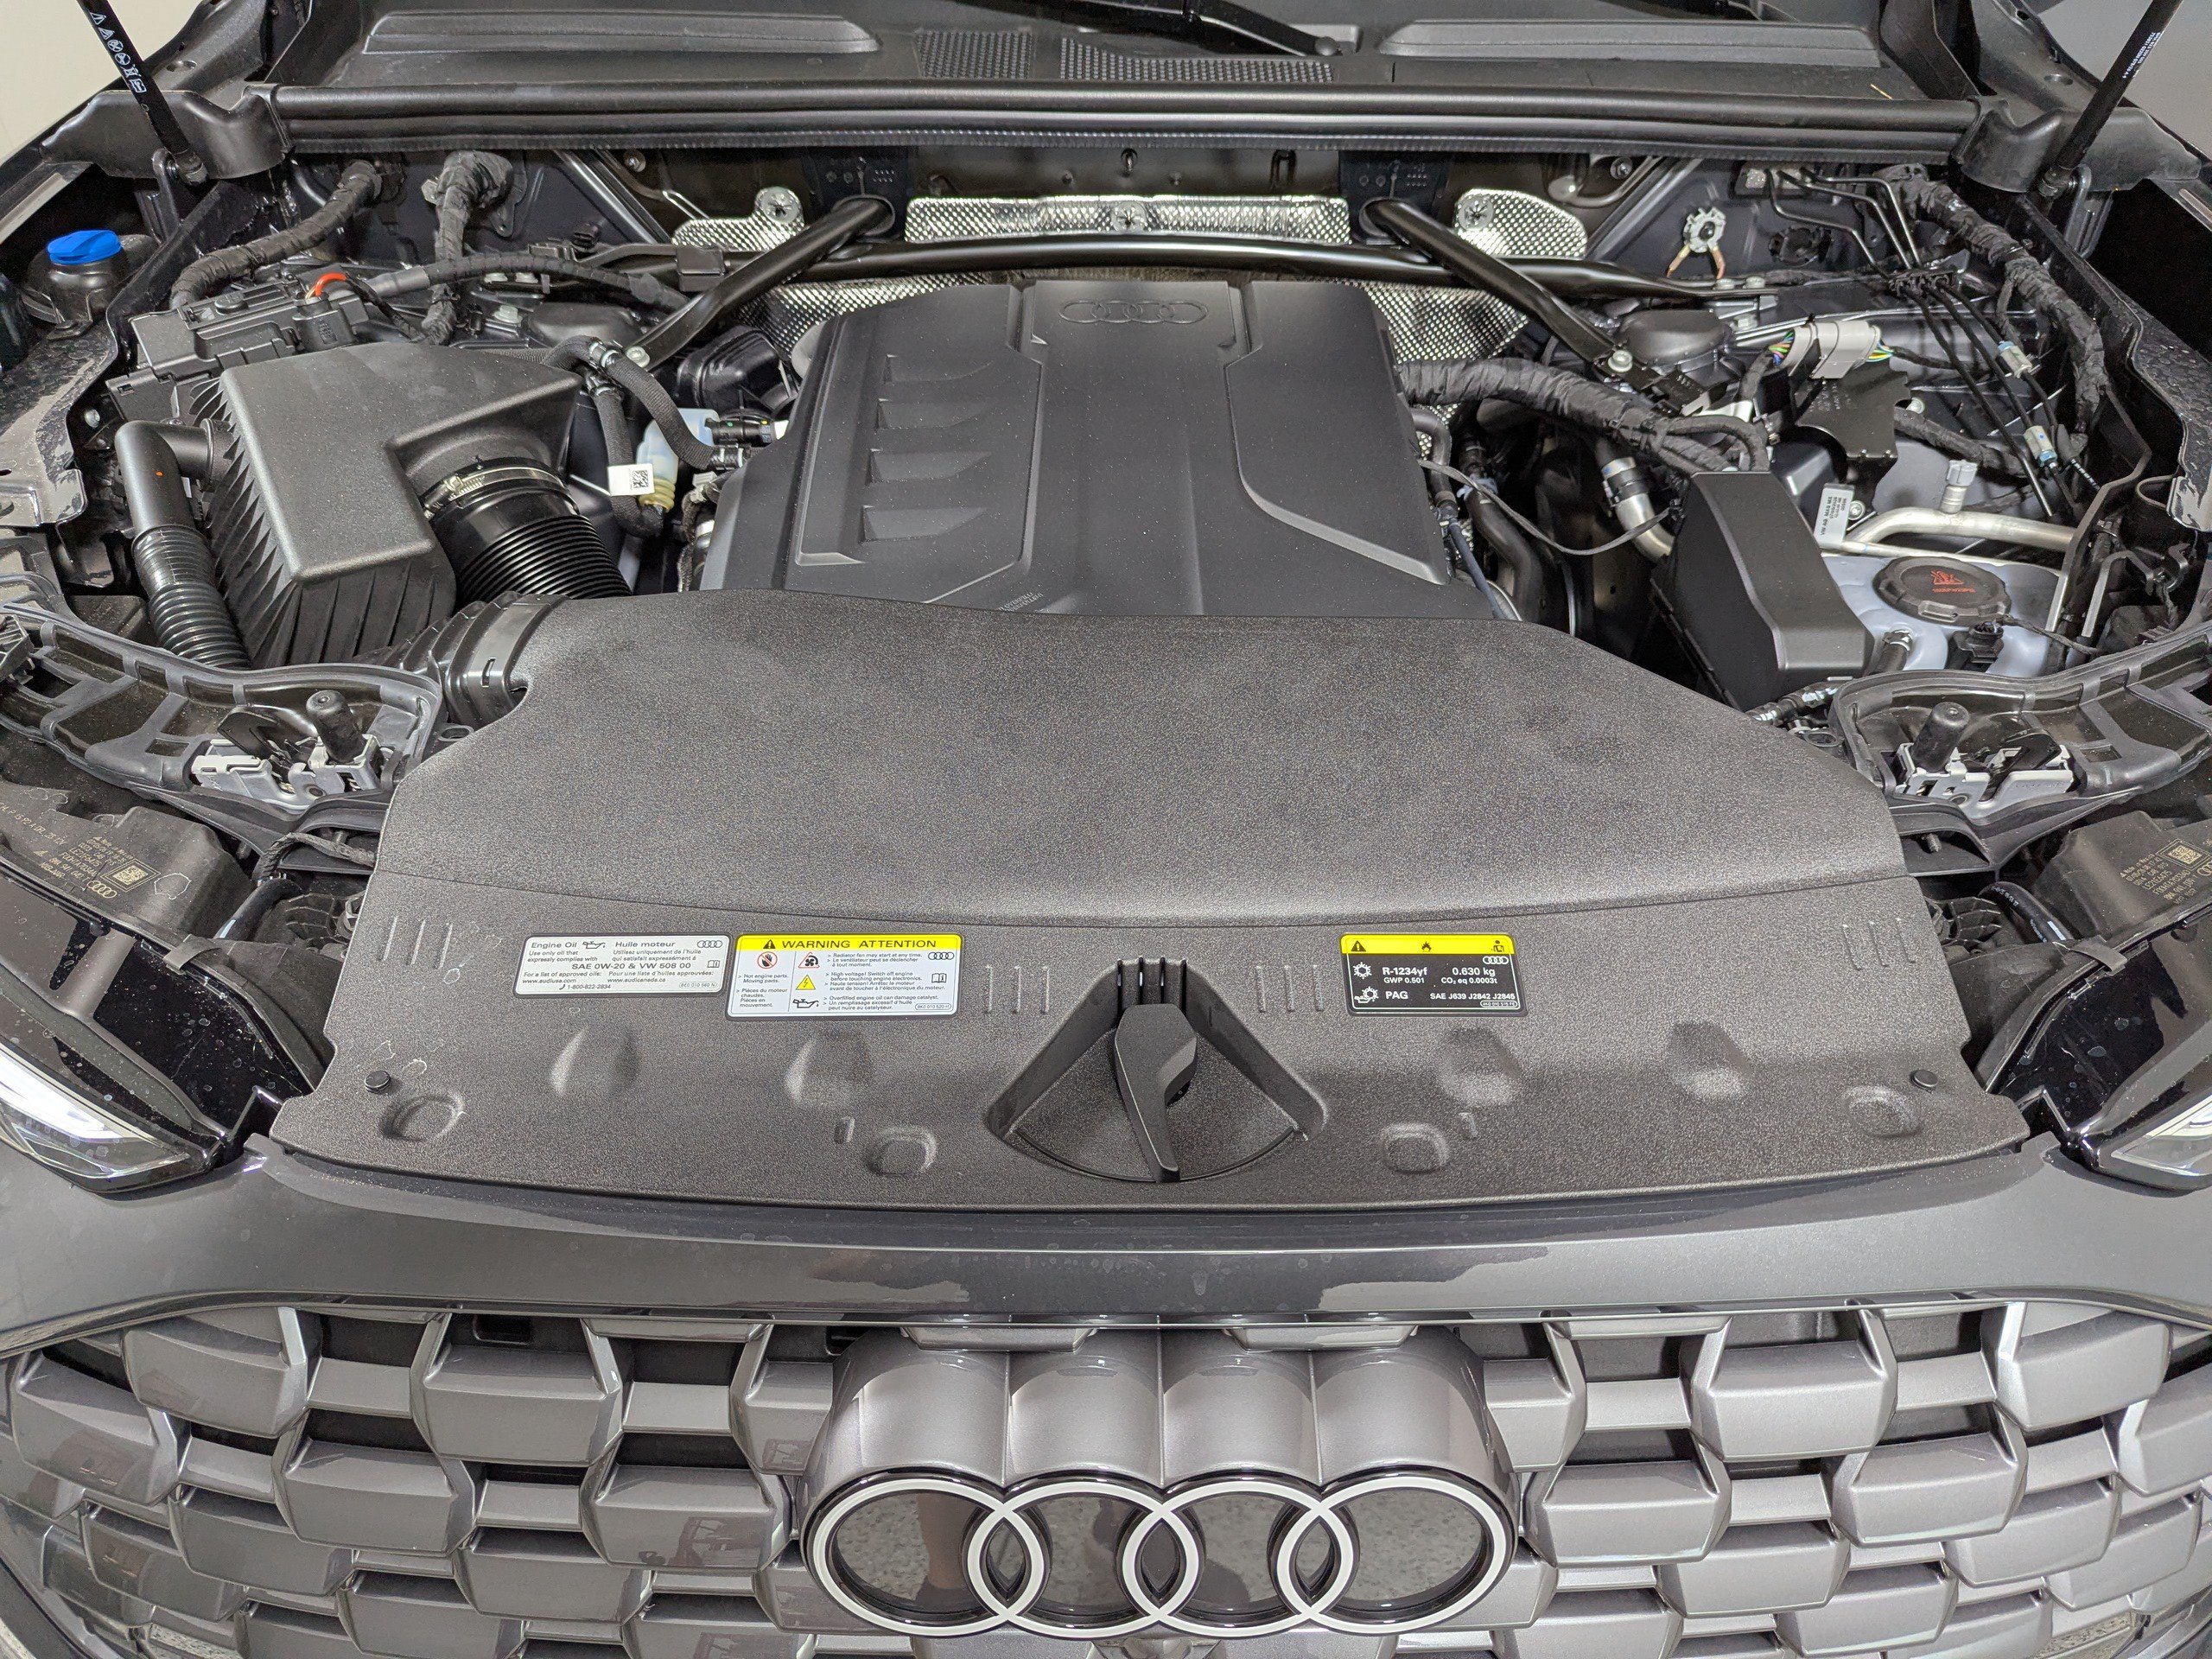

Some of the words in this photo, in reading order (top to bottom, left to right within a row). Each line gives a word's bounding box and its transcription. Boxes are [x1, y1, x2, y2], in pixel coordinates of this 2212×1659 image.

[1382, 967, 1427, 976] R-1234yf
[1452, 967, 1480, 976] 0.630
[1483, 967, 1495, 976] kg
[1386, 991, 1408, 1000] PAG
